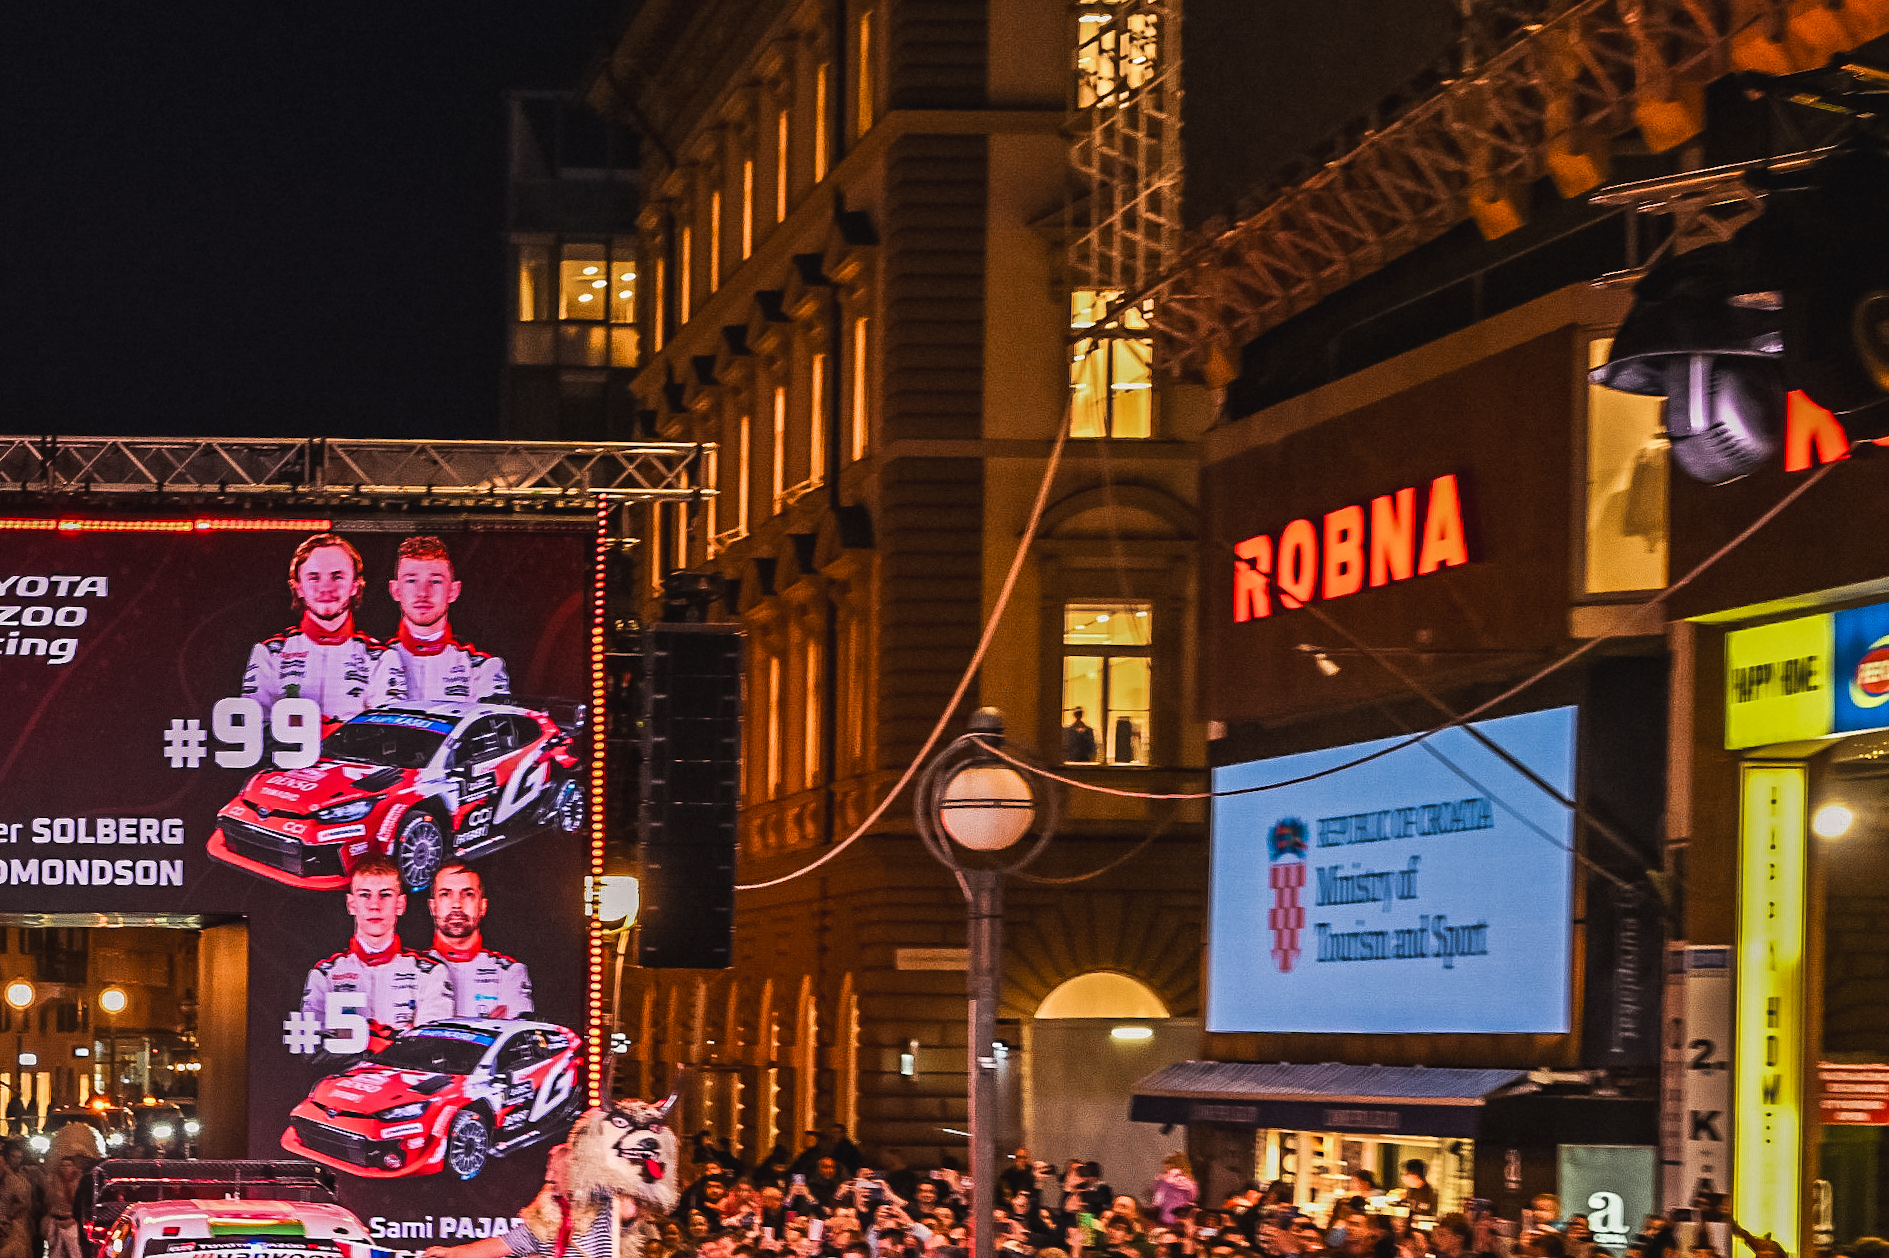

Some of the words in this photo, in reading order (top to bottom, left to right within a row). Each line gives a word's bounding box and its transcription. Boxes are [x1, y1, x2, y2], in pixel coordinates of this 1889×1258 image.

[1234, 474, 1469, 623] ROBNA
[163, 697, 322, 768] #99
[31, 818, 185, 845] SOLBERG
[283, 992, 370, 1054] #5
[369, 1216, 433, 1239] Sami
